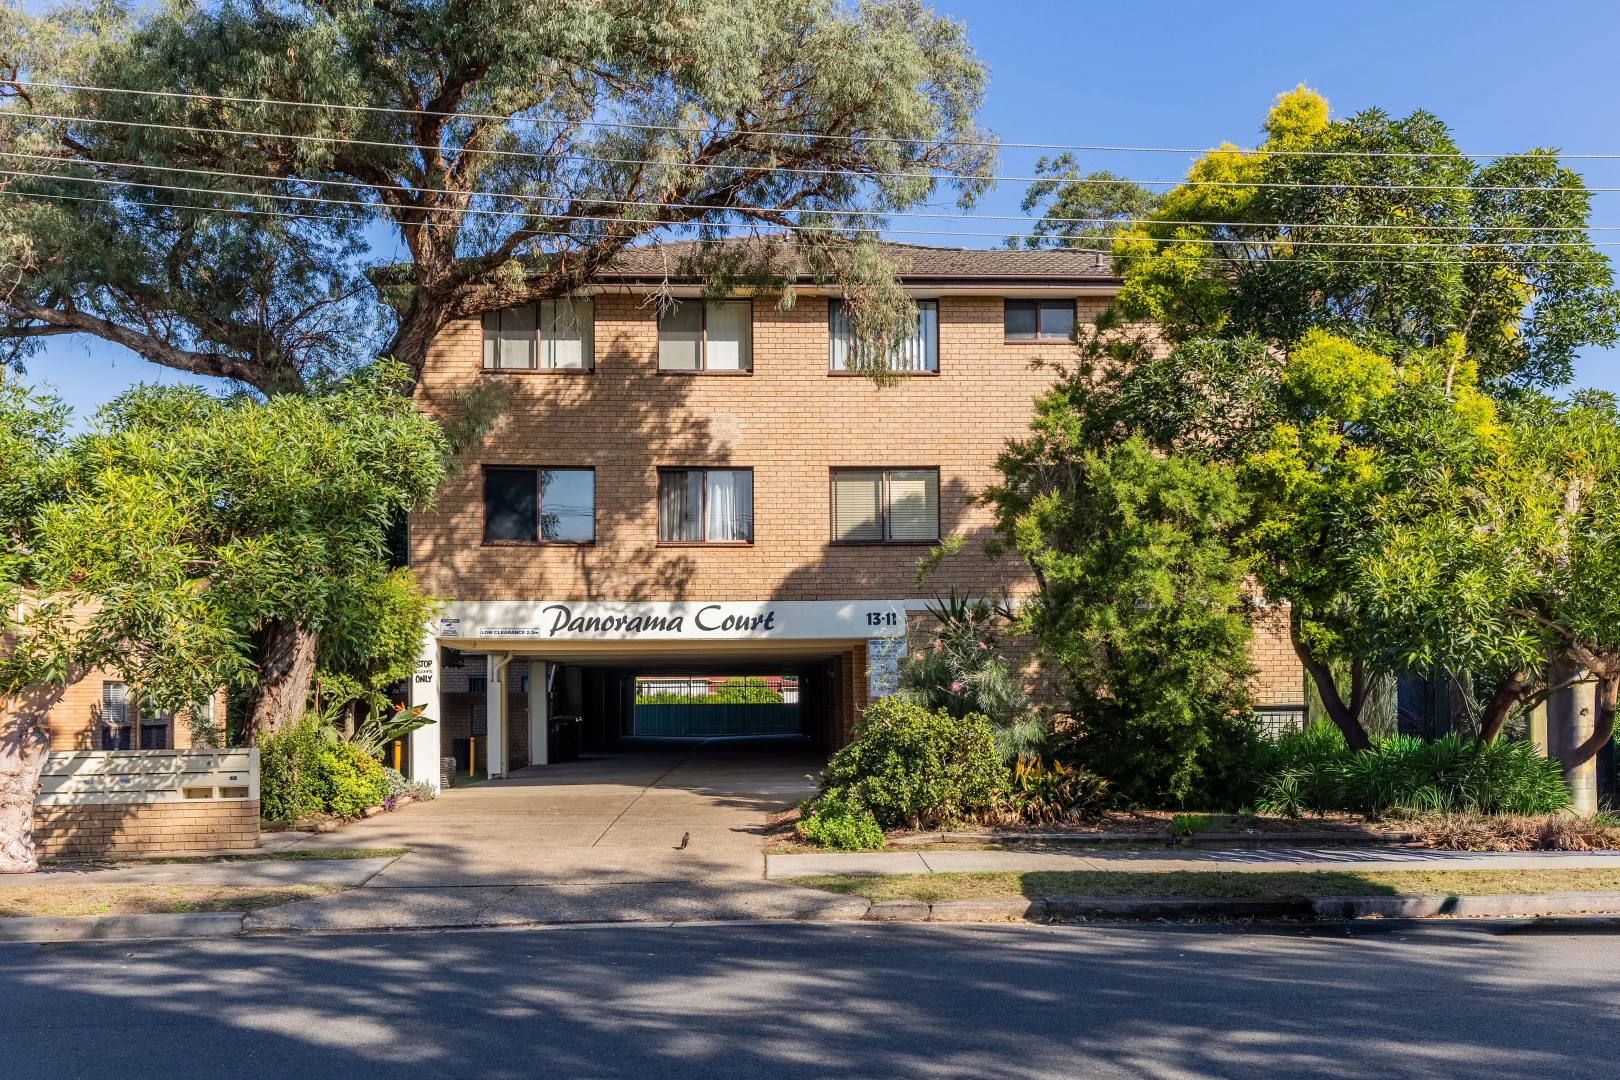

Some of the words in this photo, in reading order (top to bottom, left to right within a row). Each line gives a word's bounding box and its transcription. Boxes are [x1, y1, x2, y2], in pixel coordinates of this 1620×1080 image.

[542, 604, 684, 637] Panorama
[695, 604, 775, 631] Court
[867, 612, 897, 625] 13-11
[416, 659, 433, 668] STOP
[415, 674, 433, 683] ONLY
